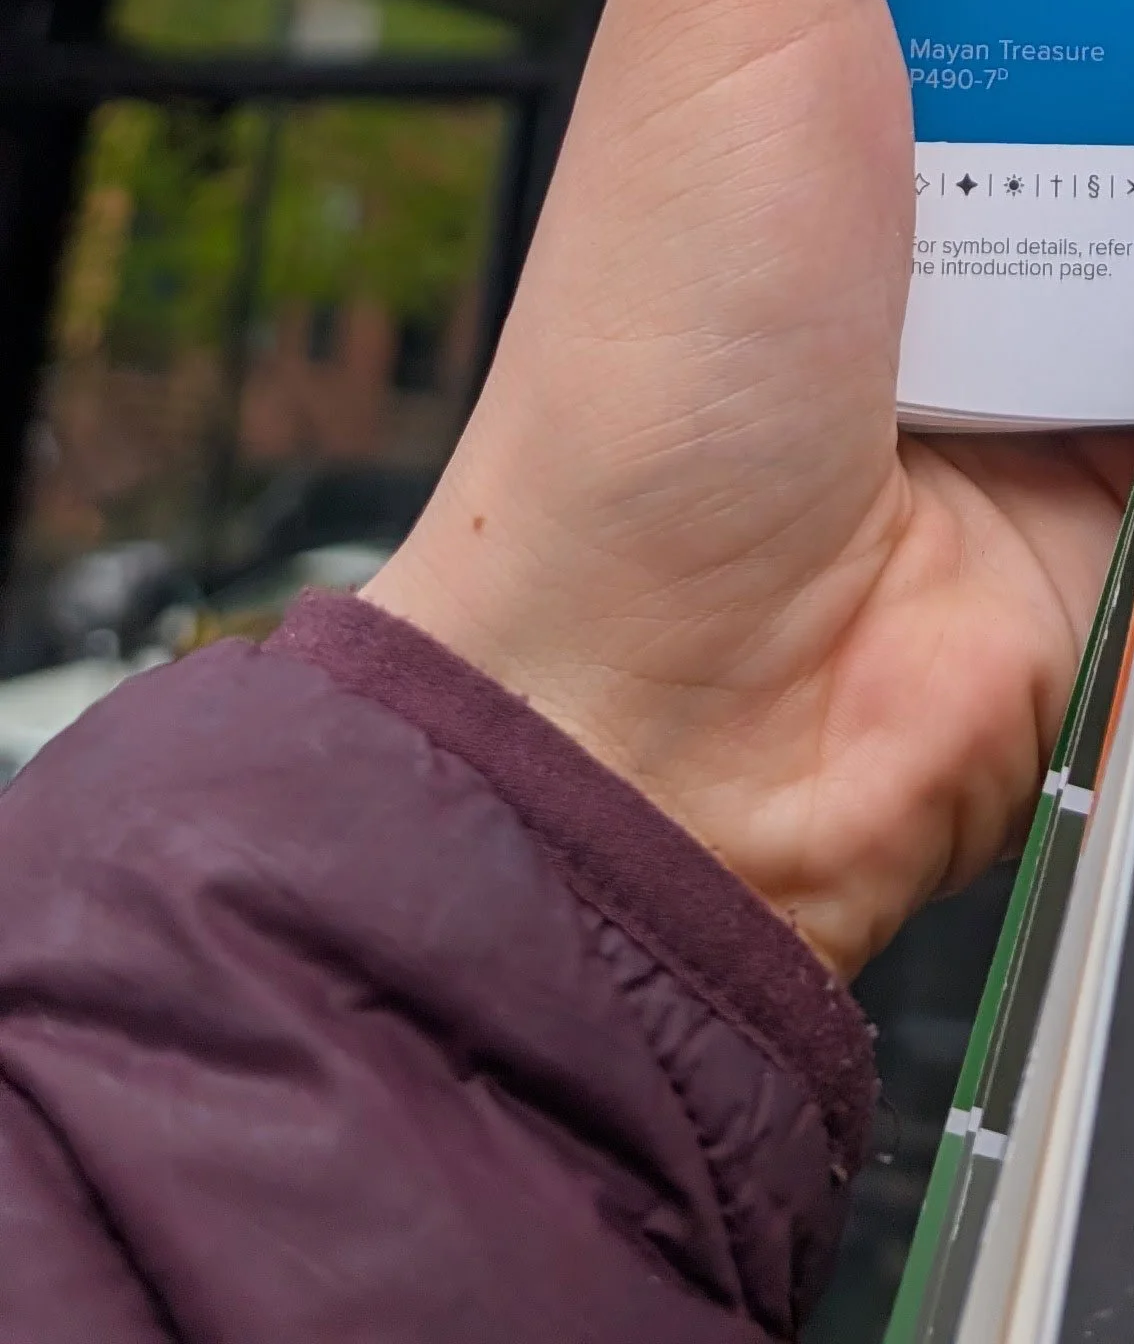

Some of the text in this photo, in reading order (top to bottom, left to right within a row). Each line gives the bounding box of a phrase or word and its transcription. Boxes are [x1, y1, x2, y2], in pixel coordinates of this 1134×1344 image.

[909, 37, 1105, 65] Mayan Treasure
[941, 237, 1011, 258] symbol
[1016, 237, 1083, 258] details,
[1088, 238, 1133, 257] refer
[910, 257, 1113, 282] he introduction page.
